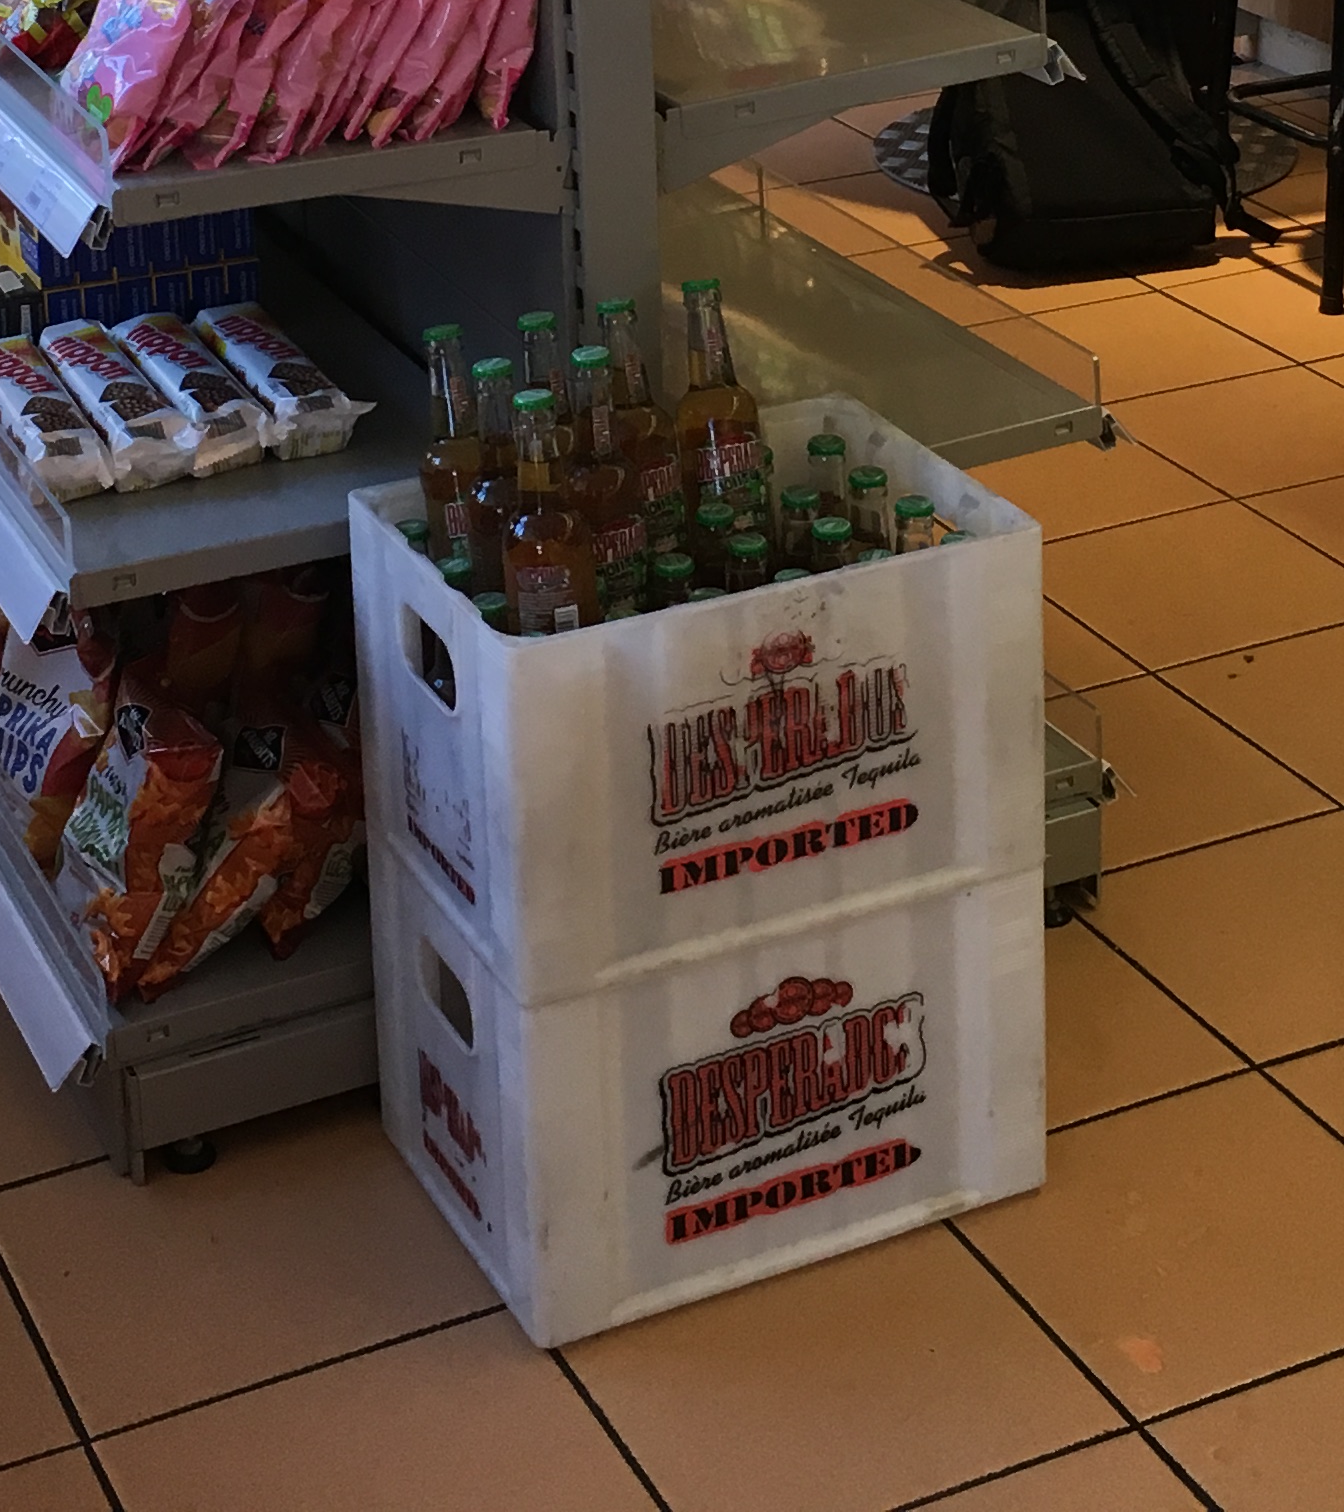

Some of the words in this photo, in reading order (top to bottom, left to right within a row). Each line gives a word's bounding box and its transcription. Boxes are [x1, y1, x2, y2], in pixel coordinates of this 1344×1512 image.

[49, 335, 134, 380] nippon
[127, 322, 213, 369] nippon
[215, 314, 305, 360] nippon
[654, 826, 712, 856] Bière
[718, 782, 834, 833] aromatisée
[841, 748, 921, 790] Tequila
[659, 801, 919, 895] IMPORTED
[665, 1174, 723, 1206] Bière
[728, 1123, 841, 1180] aromatisée
[848, 1085, 926, 1130] Tequila
[670, 1142, 921, 1241] IMPORTED
